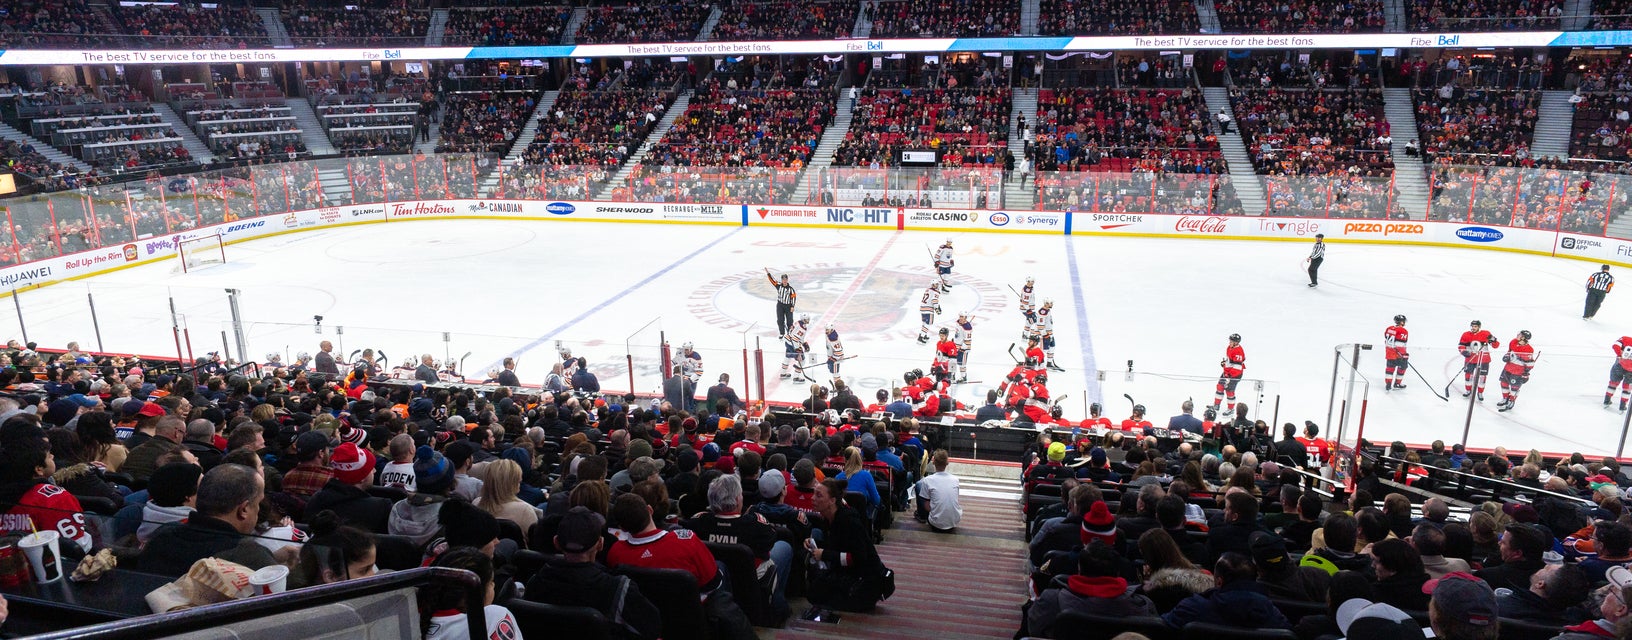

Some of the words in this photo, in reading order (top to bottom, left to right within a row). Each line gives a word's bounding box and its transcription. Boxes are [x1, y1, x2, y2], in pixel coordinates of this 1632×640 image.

[846, 42, 864, 51] Fibe
[867, 41, 883, 50] Bell
[1134, 38, 1151, 46] The
[1153, 38, 1174, 46] best
[1177, 38, 1190, 46] TV
[1192, 38, 1228, 46] service
[1230, 38, 1246, 46] for
[1248, 37, 1264, 46] the
[1266, 37, 1288, 46] best
[1291, 37, 1315, 46] fans.
[1410, 37, 1432, 46] Fibe
[1438, 35, 1460, 46] Bell
[627, 45, 642, 54] The
[643, 45, 660, 54] best
[662, 45, 673, 53] TV
[674, 45, 702, 53] service
[704, 44, 716, 52] for
[717, 44, 731, 52] the
[732, 43, 751, 52] best
[752, 43, 772, 52] fans.
[82, 52, 103, 62] The
[106, 52, 130, 62] best
[133, 52, 147, 62] TV
[150, 51, 190, 62] service
[191, 51, 207, 61] for
[209, 51, 227, 61] the
[229, 51, 252, 61] best
[363, 51, 380, 60] Fibe
[384, 49, 401, 59] Bell
[392, 203, 413, 217] Tim
[414, 202, 455, 215] Hortons
[489, 202, 522, 213] CANADIAN
[596, 206, 653, 214] SHER-WOOD
[663, 205, 694, 213] RECHARGE
[700, 205, 723, 214] MILK
[771, 209, 803, 217] CANADIAN
[804, 210, 817, 218] TIRE
[864, 209, 891, 224] HIT
[227, 220, 266, 233] BOEING
[1027, 216, 1058, 226] Synergy
[1344, 222, 1382, 235] pizza
[1384, 223, 1424, 236] pizza
[1576, 238, 1602, 248] OFFICIAL
[65, 259, 80, 270] Roll
[82, 257, 93, 268] Up
[94, 254, 107, 264] the
[108, 252, 122, 261] Rim
[0, 266, 52, 287] HUAWEI
[382, 472, 414, 486] EDDEN
[709, 534, 738, 544] RYAN
